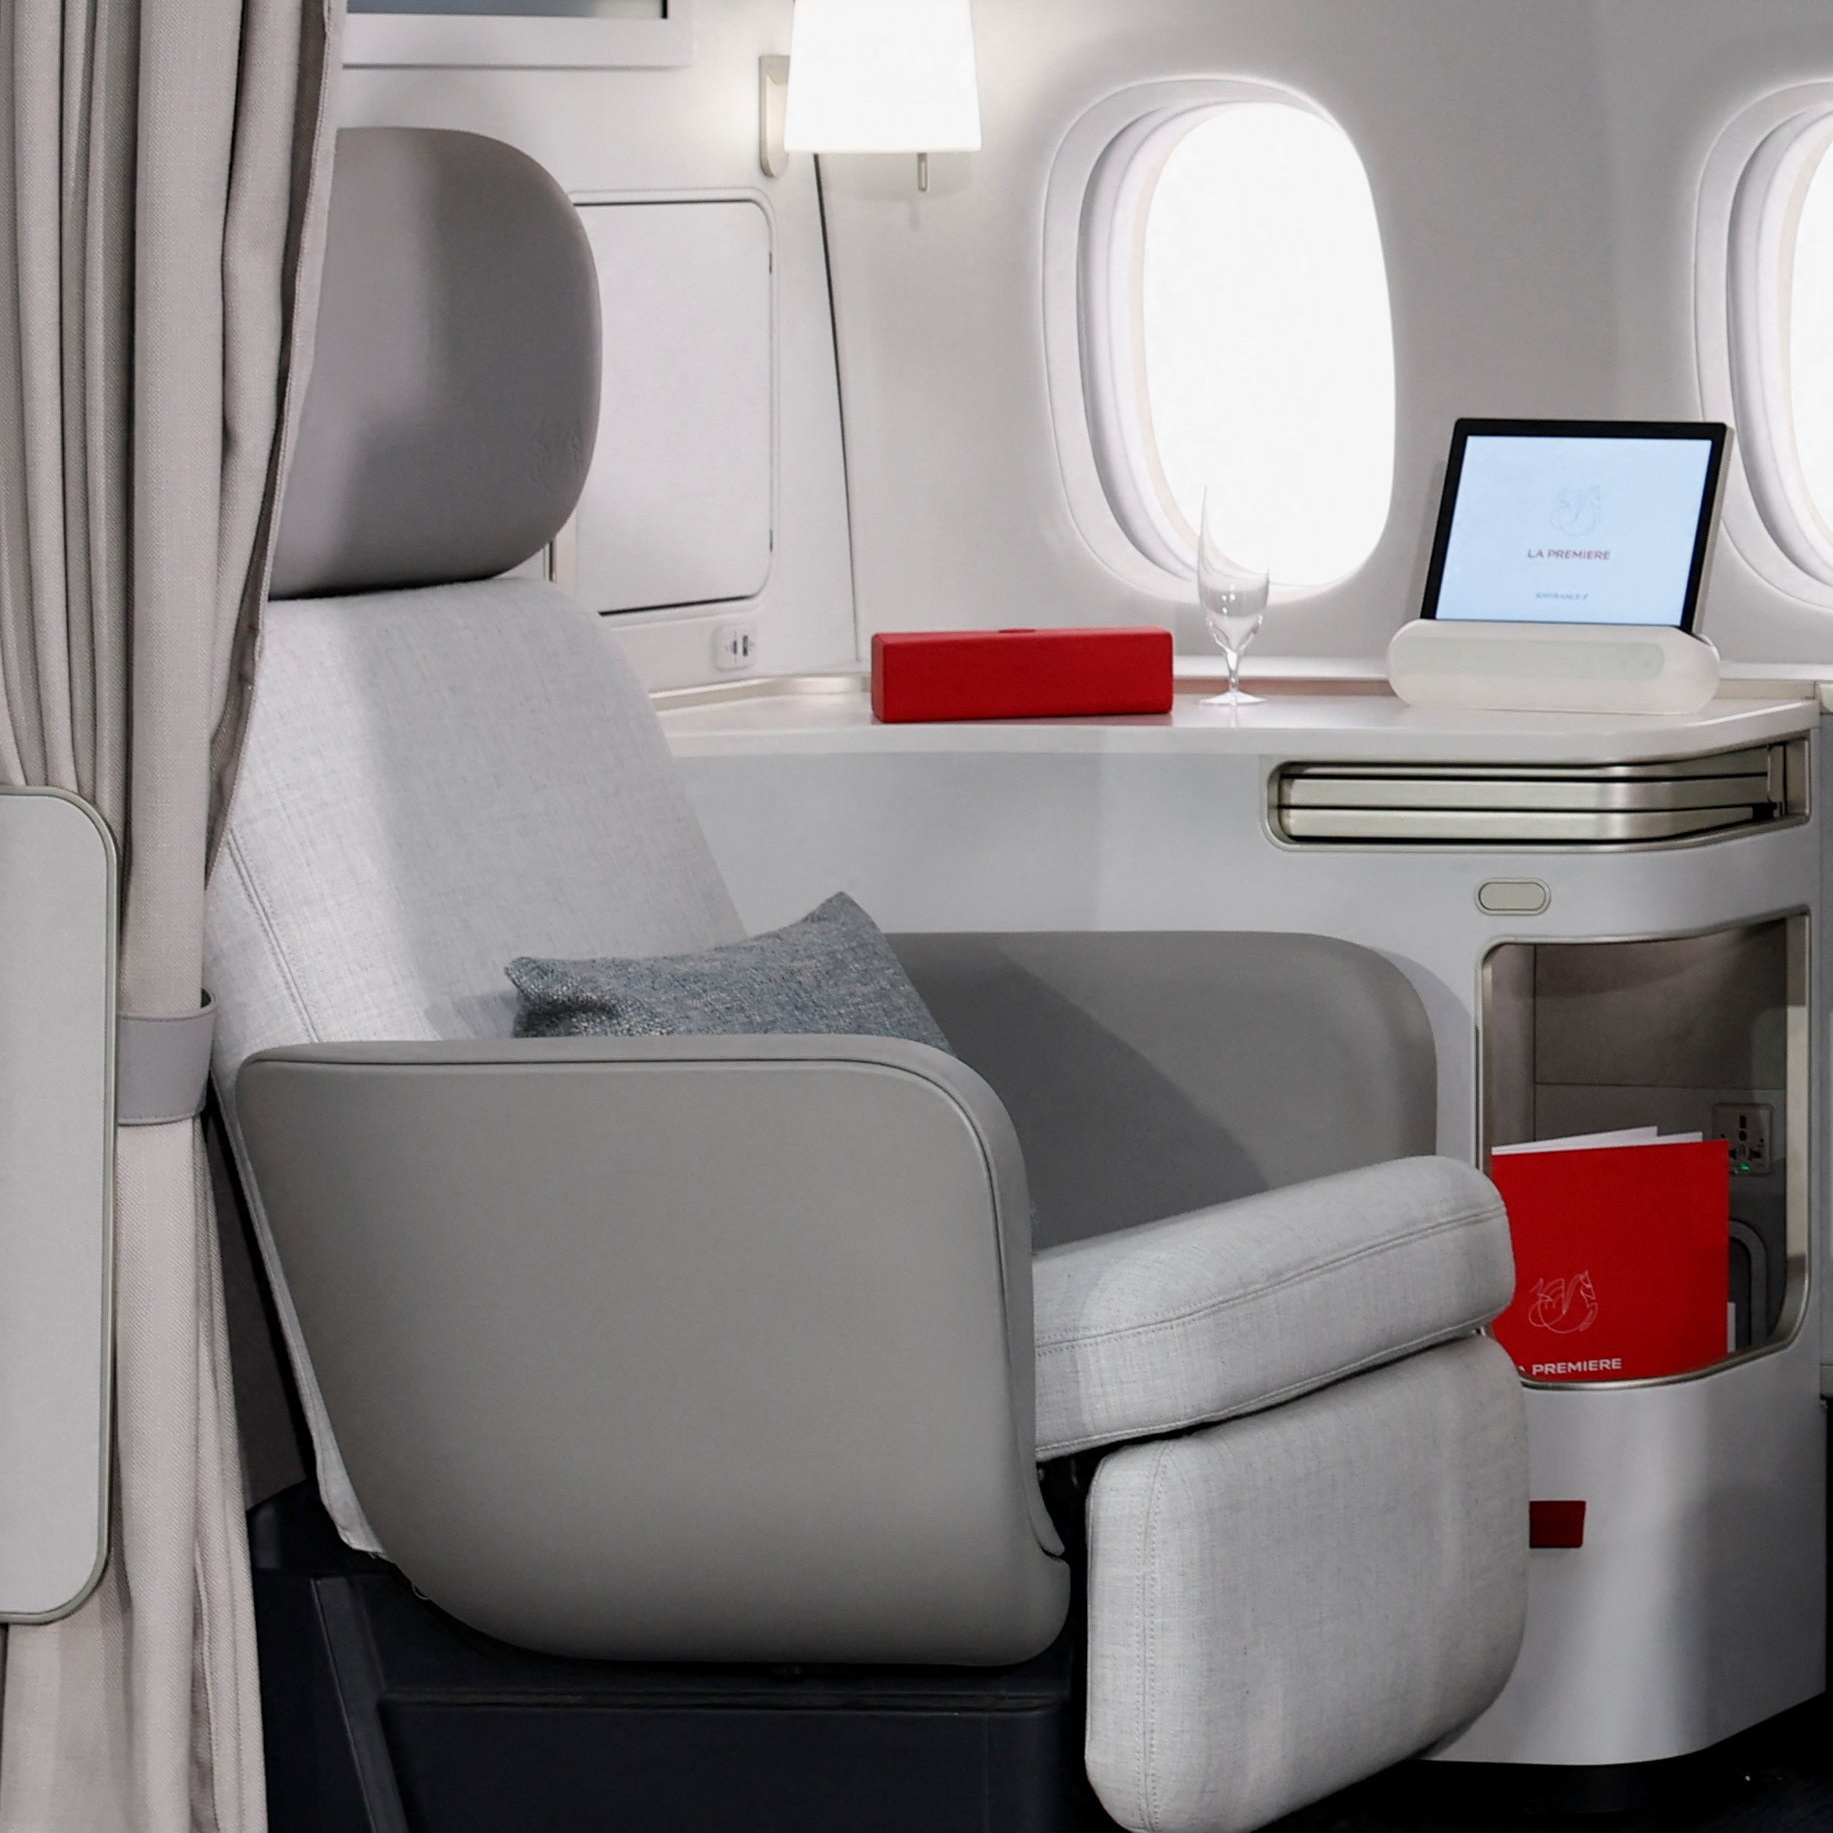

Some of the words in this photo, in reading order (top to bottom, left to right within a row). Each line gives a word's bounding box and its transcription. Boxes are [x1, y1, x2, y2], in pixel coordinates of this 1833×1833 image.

[1527, 549, 1545, 559] LA
[1547, 549, 1611, 560] PREMIERE
[1532, 1357, 1622, 1376] PREMIERE
